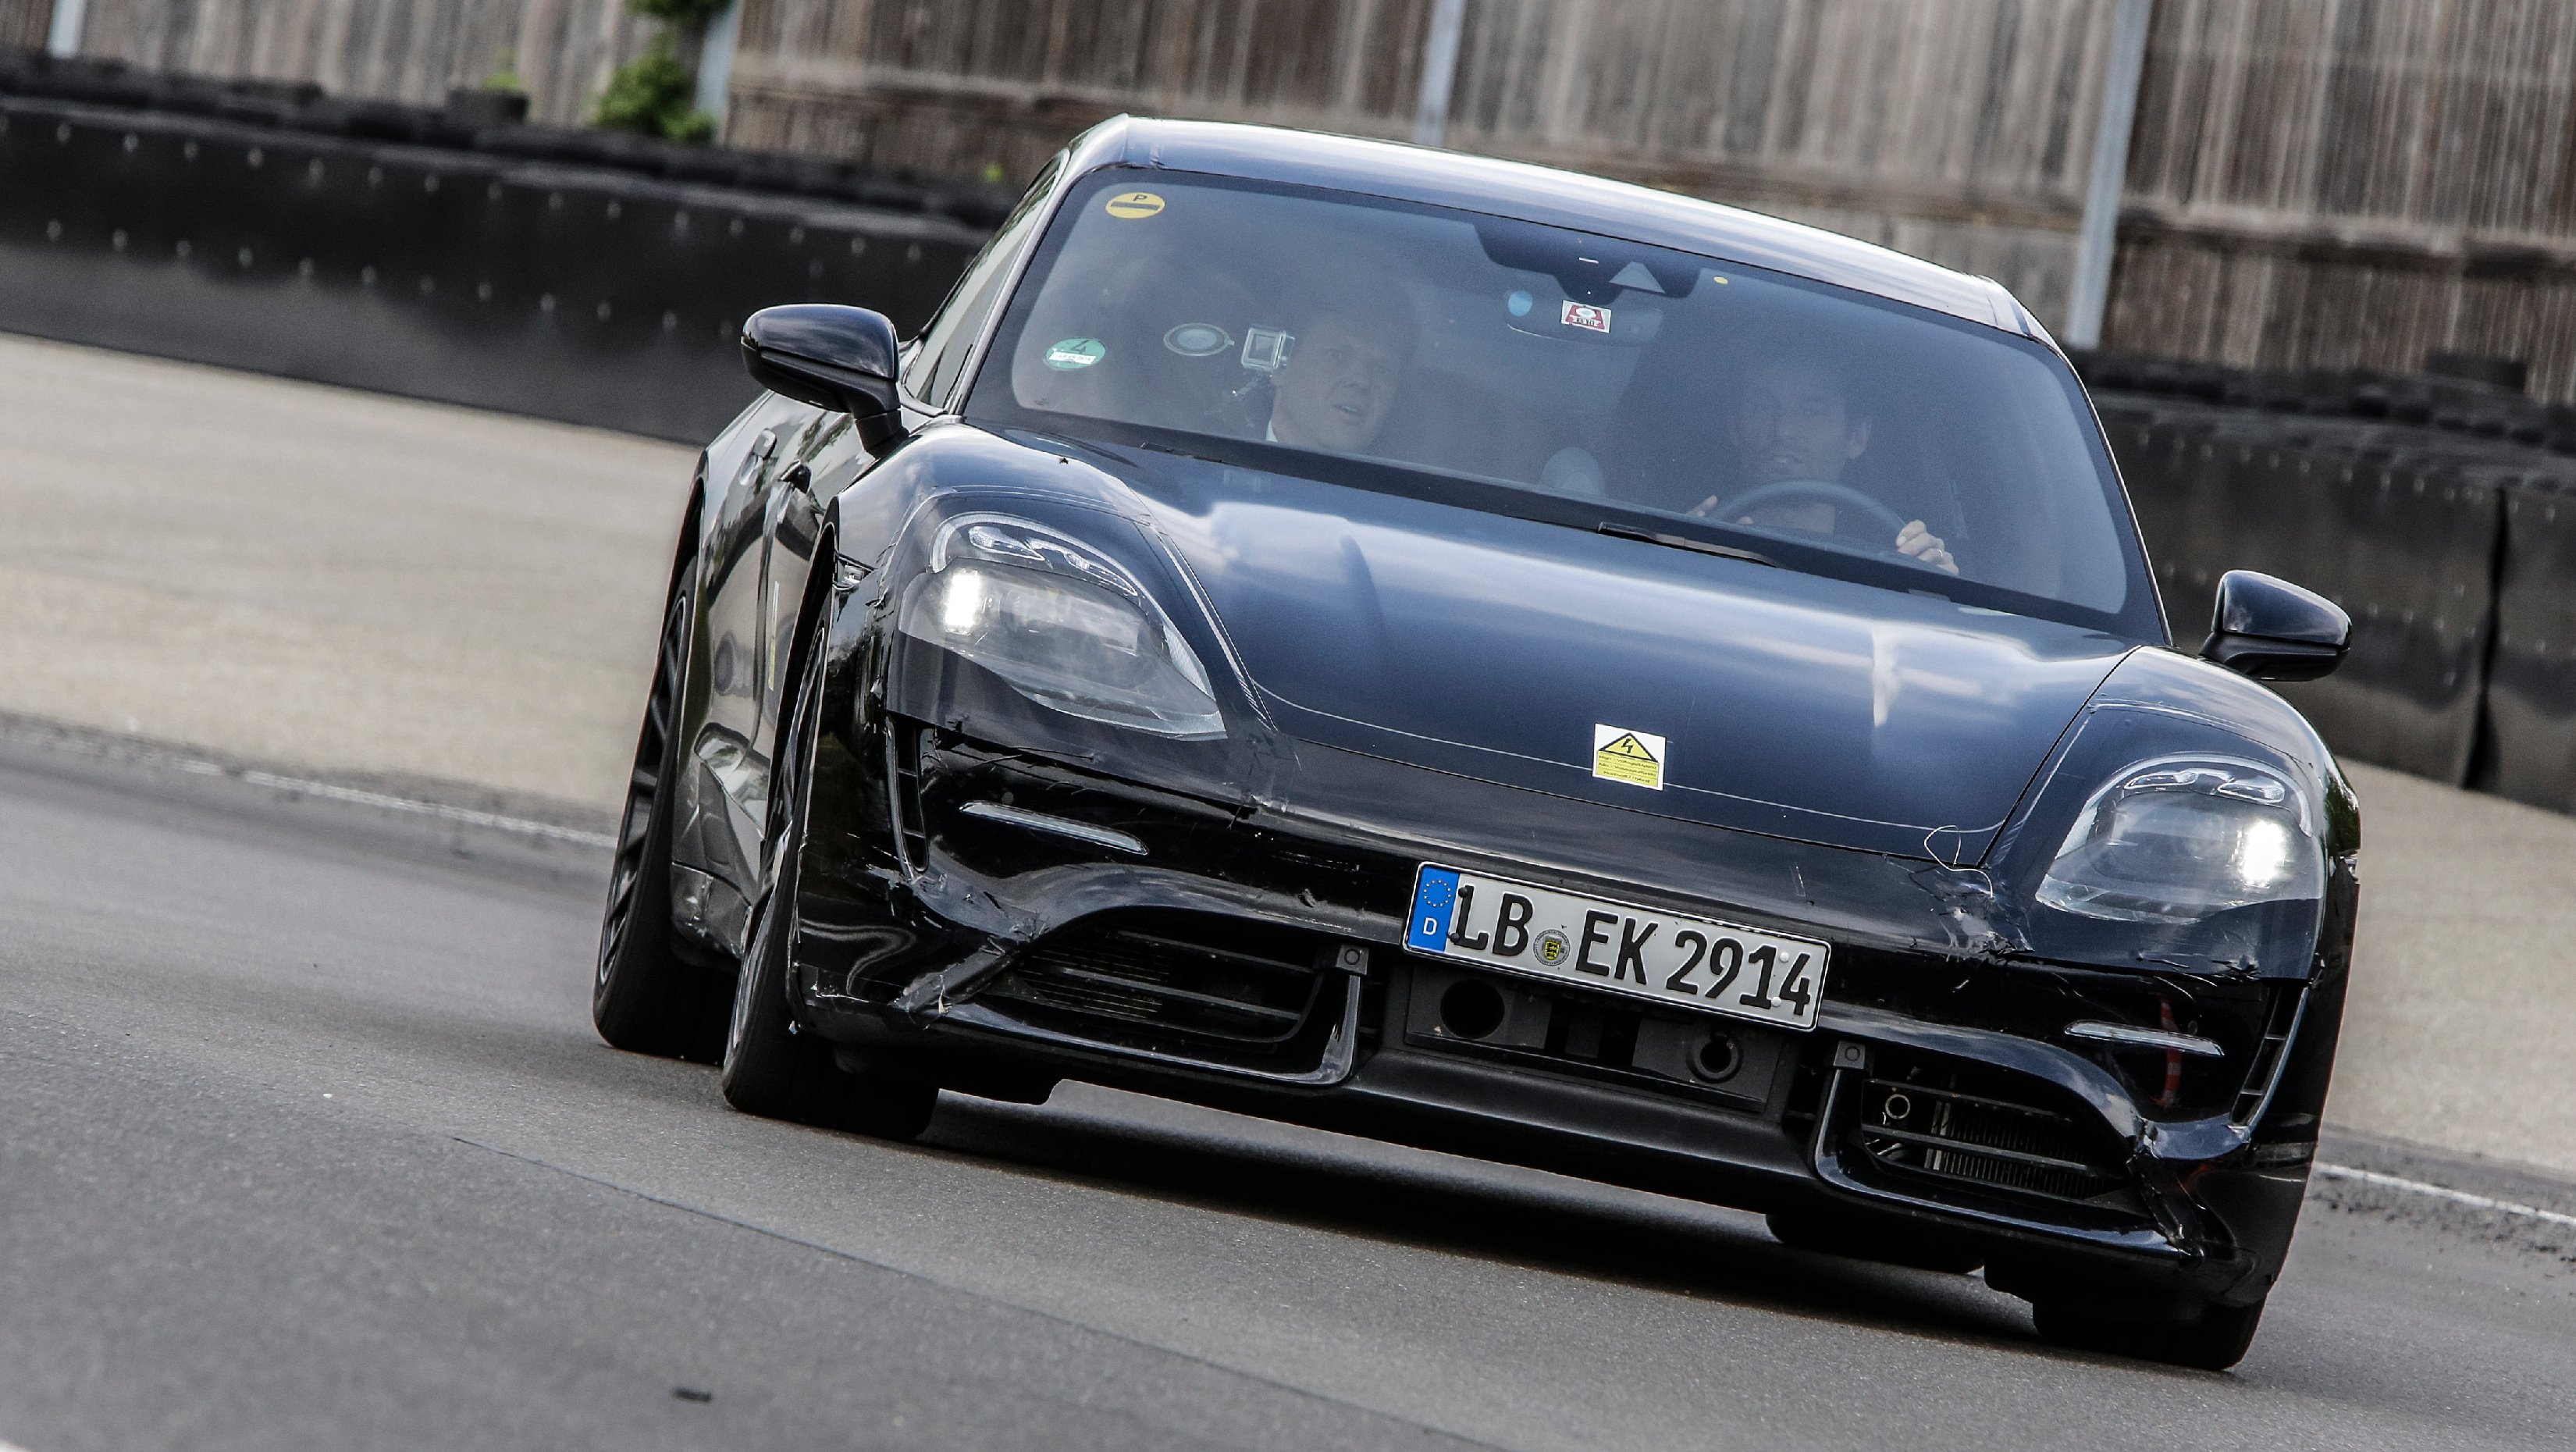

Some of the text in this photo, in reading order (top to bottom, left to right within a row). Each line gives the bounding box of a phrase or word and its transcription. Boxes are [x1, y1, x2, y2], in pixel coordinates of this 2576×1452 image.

[1422, 917, 1438, 936] D
[1454, 884, 1534, 957] LB
[1575, 909, 1660, 986] EK
[1666, 930, 1811, 1016] 2914
